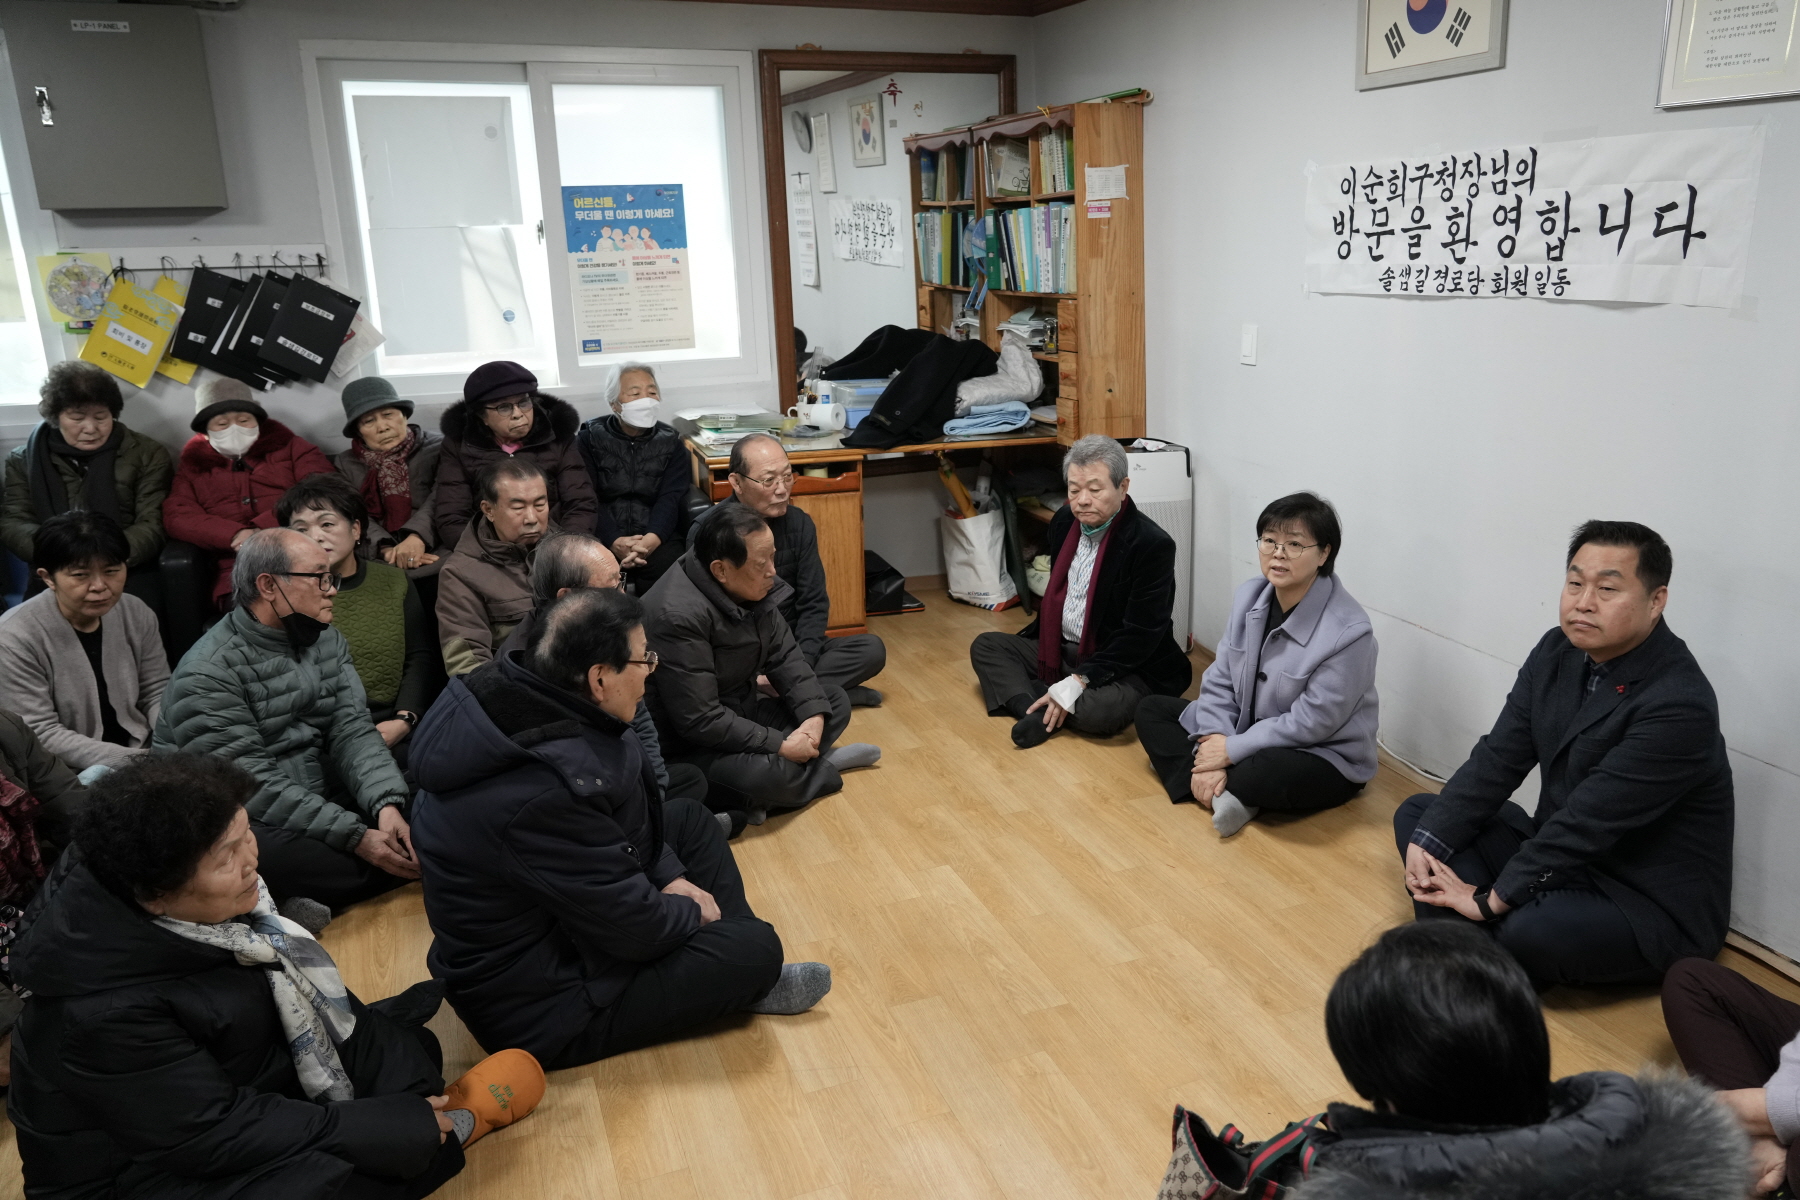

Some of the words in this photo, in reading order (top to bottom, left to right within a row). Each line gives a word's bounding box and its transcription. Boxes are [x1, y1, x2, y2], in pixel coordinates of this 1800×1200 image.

[881, 78, 903, 108] 축
[574, 197, 616, 208] 어르신들,
[575, 210, 603, 221] 무더울
[604, 210, 614, 220] 땐
[616, 208, 643, 219] 이렇게
[644, 208, 674, 218] 하세요!
